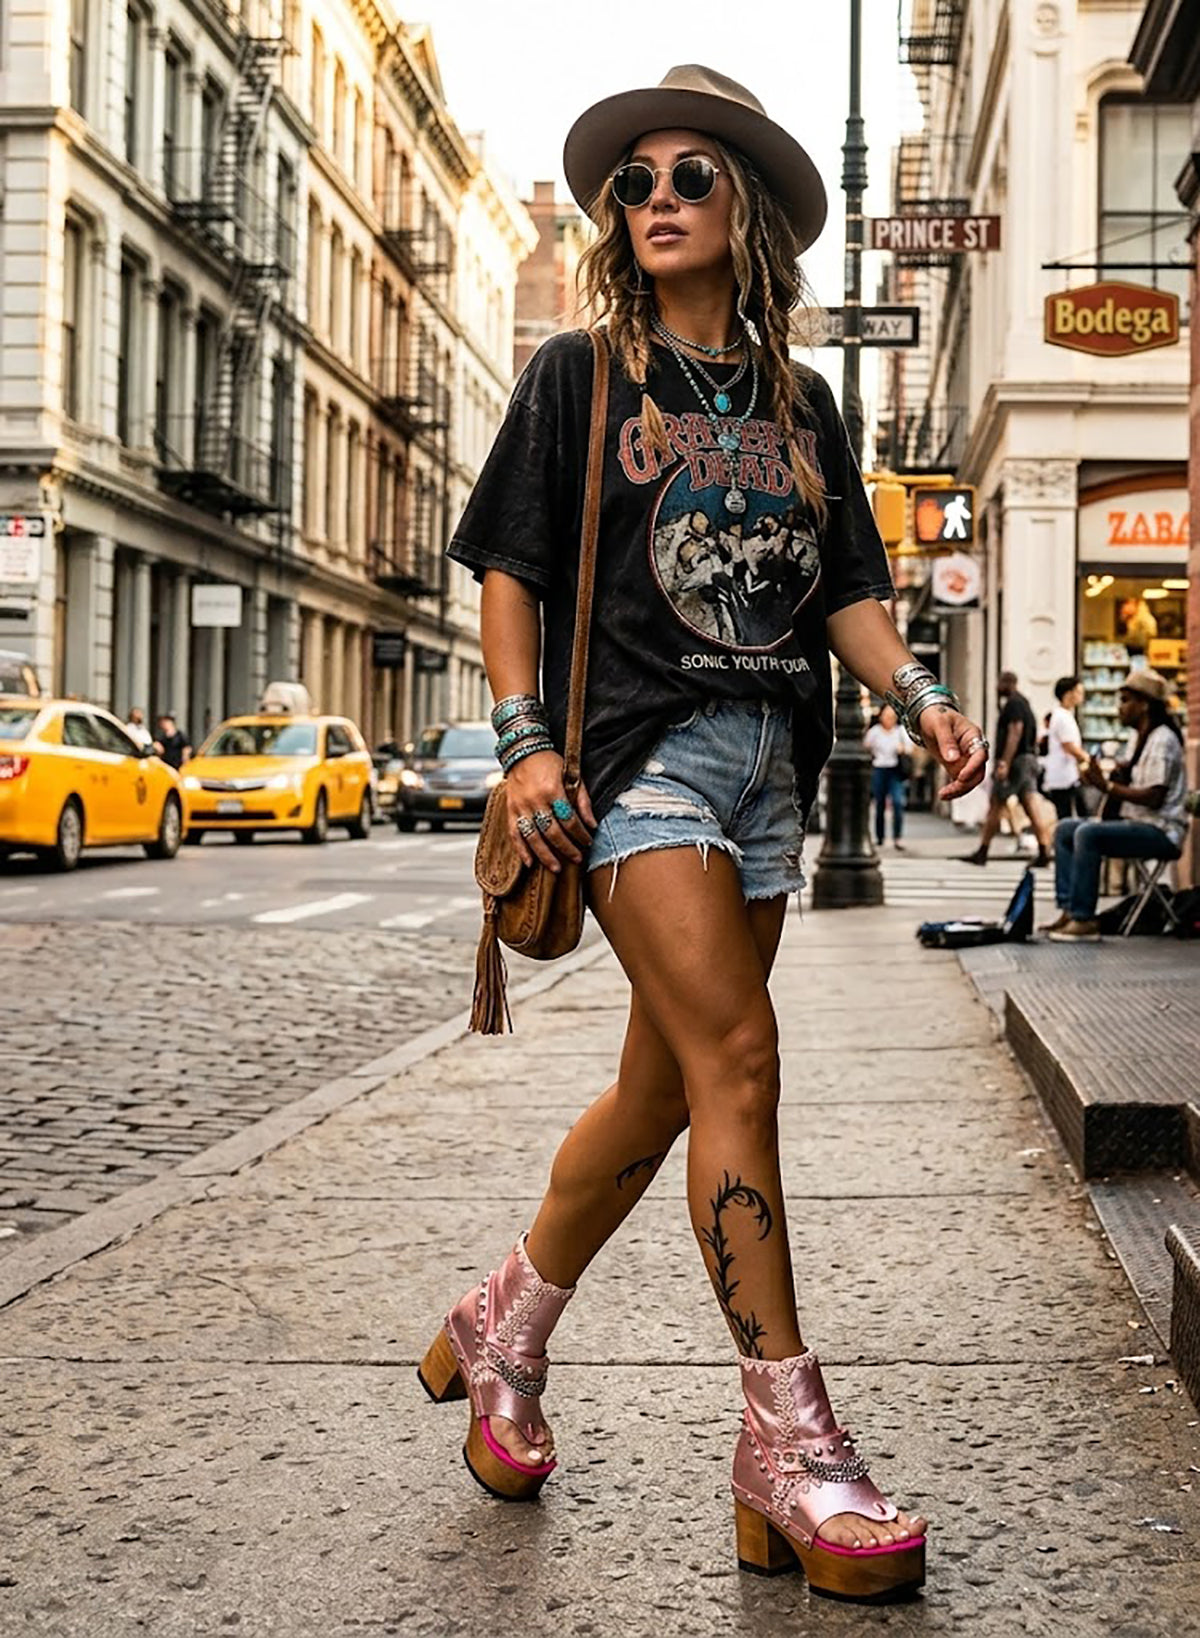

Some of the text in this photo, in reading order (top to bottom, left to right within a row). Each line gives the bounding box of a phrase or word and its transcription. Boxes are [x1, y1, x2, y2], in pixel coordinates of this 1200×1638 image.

[875, 219, 991, 249] PRINCE ST
[863, 320, 903, 335] WAY
[1055, 298, 1170, 344] Bodega
[685, 450, 794, 497] DEAD
[681, 653, 729, 670] SONIC
